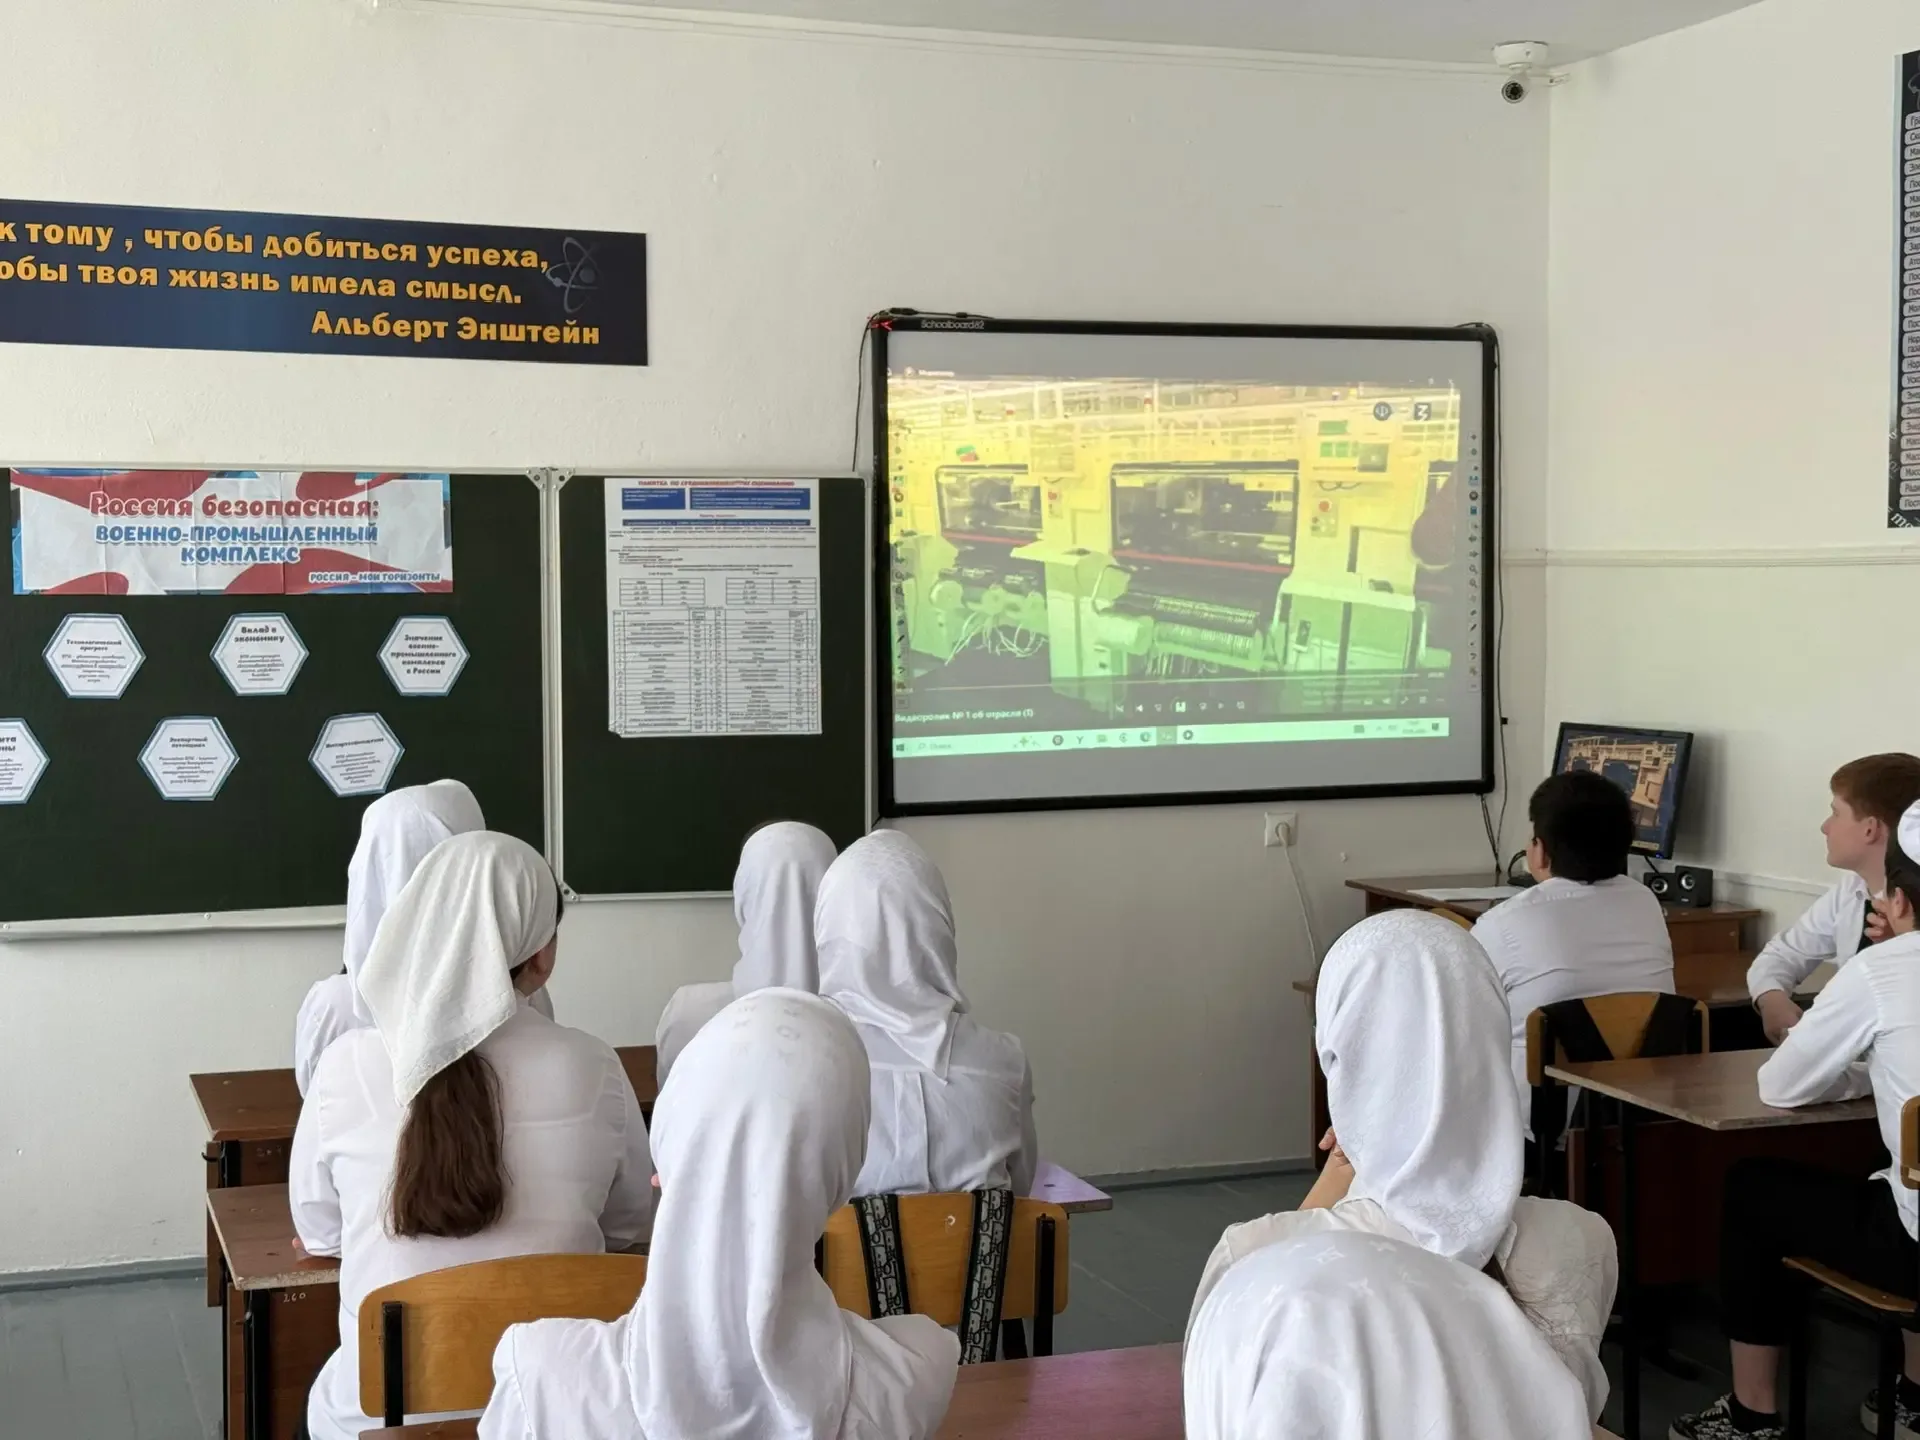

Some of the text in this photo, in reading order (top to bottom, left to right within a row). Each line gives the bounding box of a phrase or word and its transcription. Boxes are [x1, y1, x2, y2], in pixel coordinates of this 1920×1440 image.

[0, 222, 17, 242] к
[25, 223, 114, 252] тому
[144, 226, 253, 254] чтобы
[262, 231, 417, 262] добиться
[427, 244, 549, 273] успеха,
[78, 264, 158, 286] твоя
[168, 268, 280, 292] жизнь
[290, 273, 396, 297] имела
[406, 279, 522, 304] смысл.
[311, 310, 600, 344] Альберт Энштейн
[90, 491, 380, 517] Россия безопасная:
[95, 522, 379, 545] ВОЕННО-ПРОМЫШЛЕННЫЙ
[180, 546, 301, 564] КОМПЛЕКС
[310, 572, 350, 582] РОССИЯ
